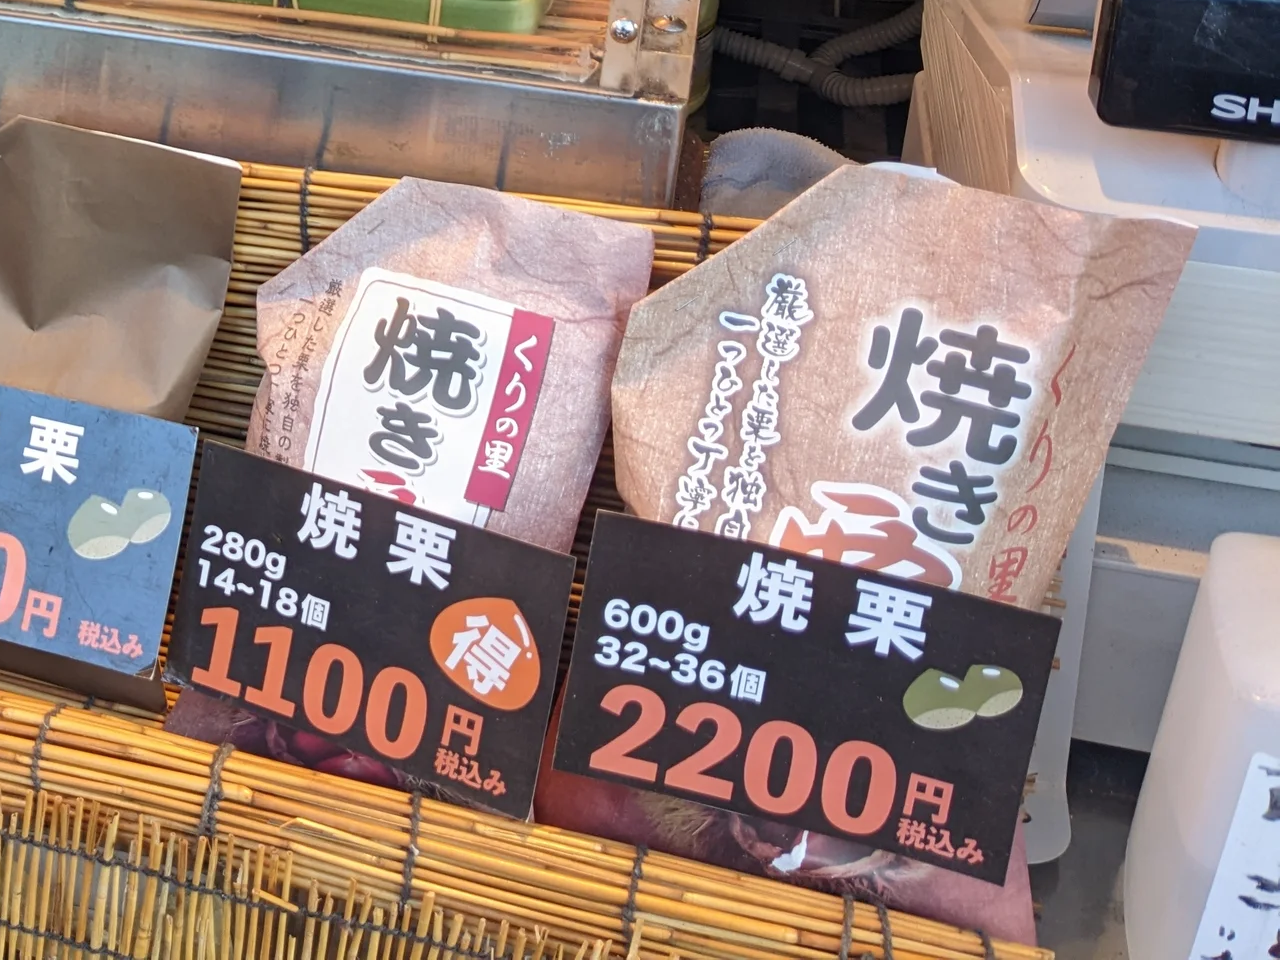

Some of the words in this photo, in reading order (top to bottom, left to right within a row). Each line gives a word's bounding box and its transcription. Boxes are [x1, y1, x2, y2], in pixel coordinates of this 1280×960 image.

[477, 334, 538, 480] くりの里
[201, 525, 287, 579] 280g
[78, 619, 143, 659] 税込み
[603, 598, 711, 653] 600g
[444, 613, 522, 696] 得
[434, 747, 507, 797] 税込み
[896, 818, 985, 866] 税込み
